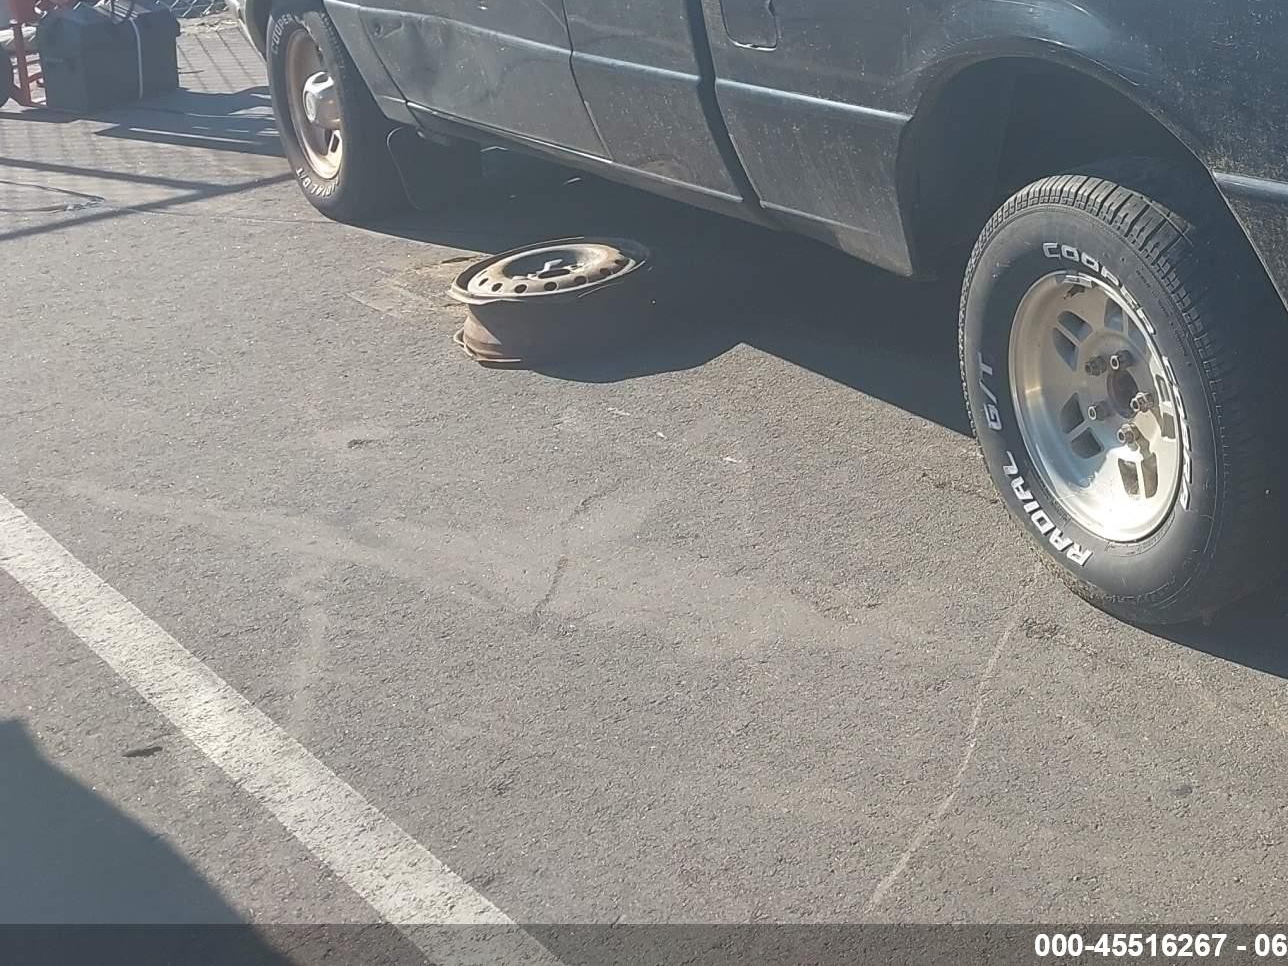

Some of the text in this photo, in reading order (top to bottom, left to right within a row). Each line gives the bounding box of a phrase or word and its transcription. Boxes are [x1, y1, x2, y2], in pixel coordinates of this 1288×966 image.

[1043, 242, 1156, 335] COOPER
[977, 352, 1094, 567] RADIAL G/T
